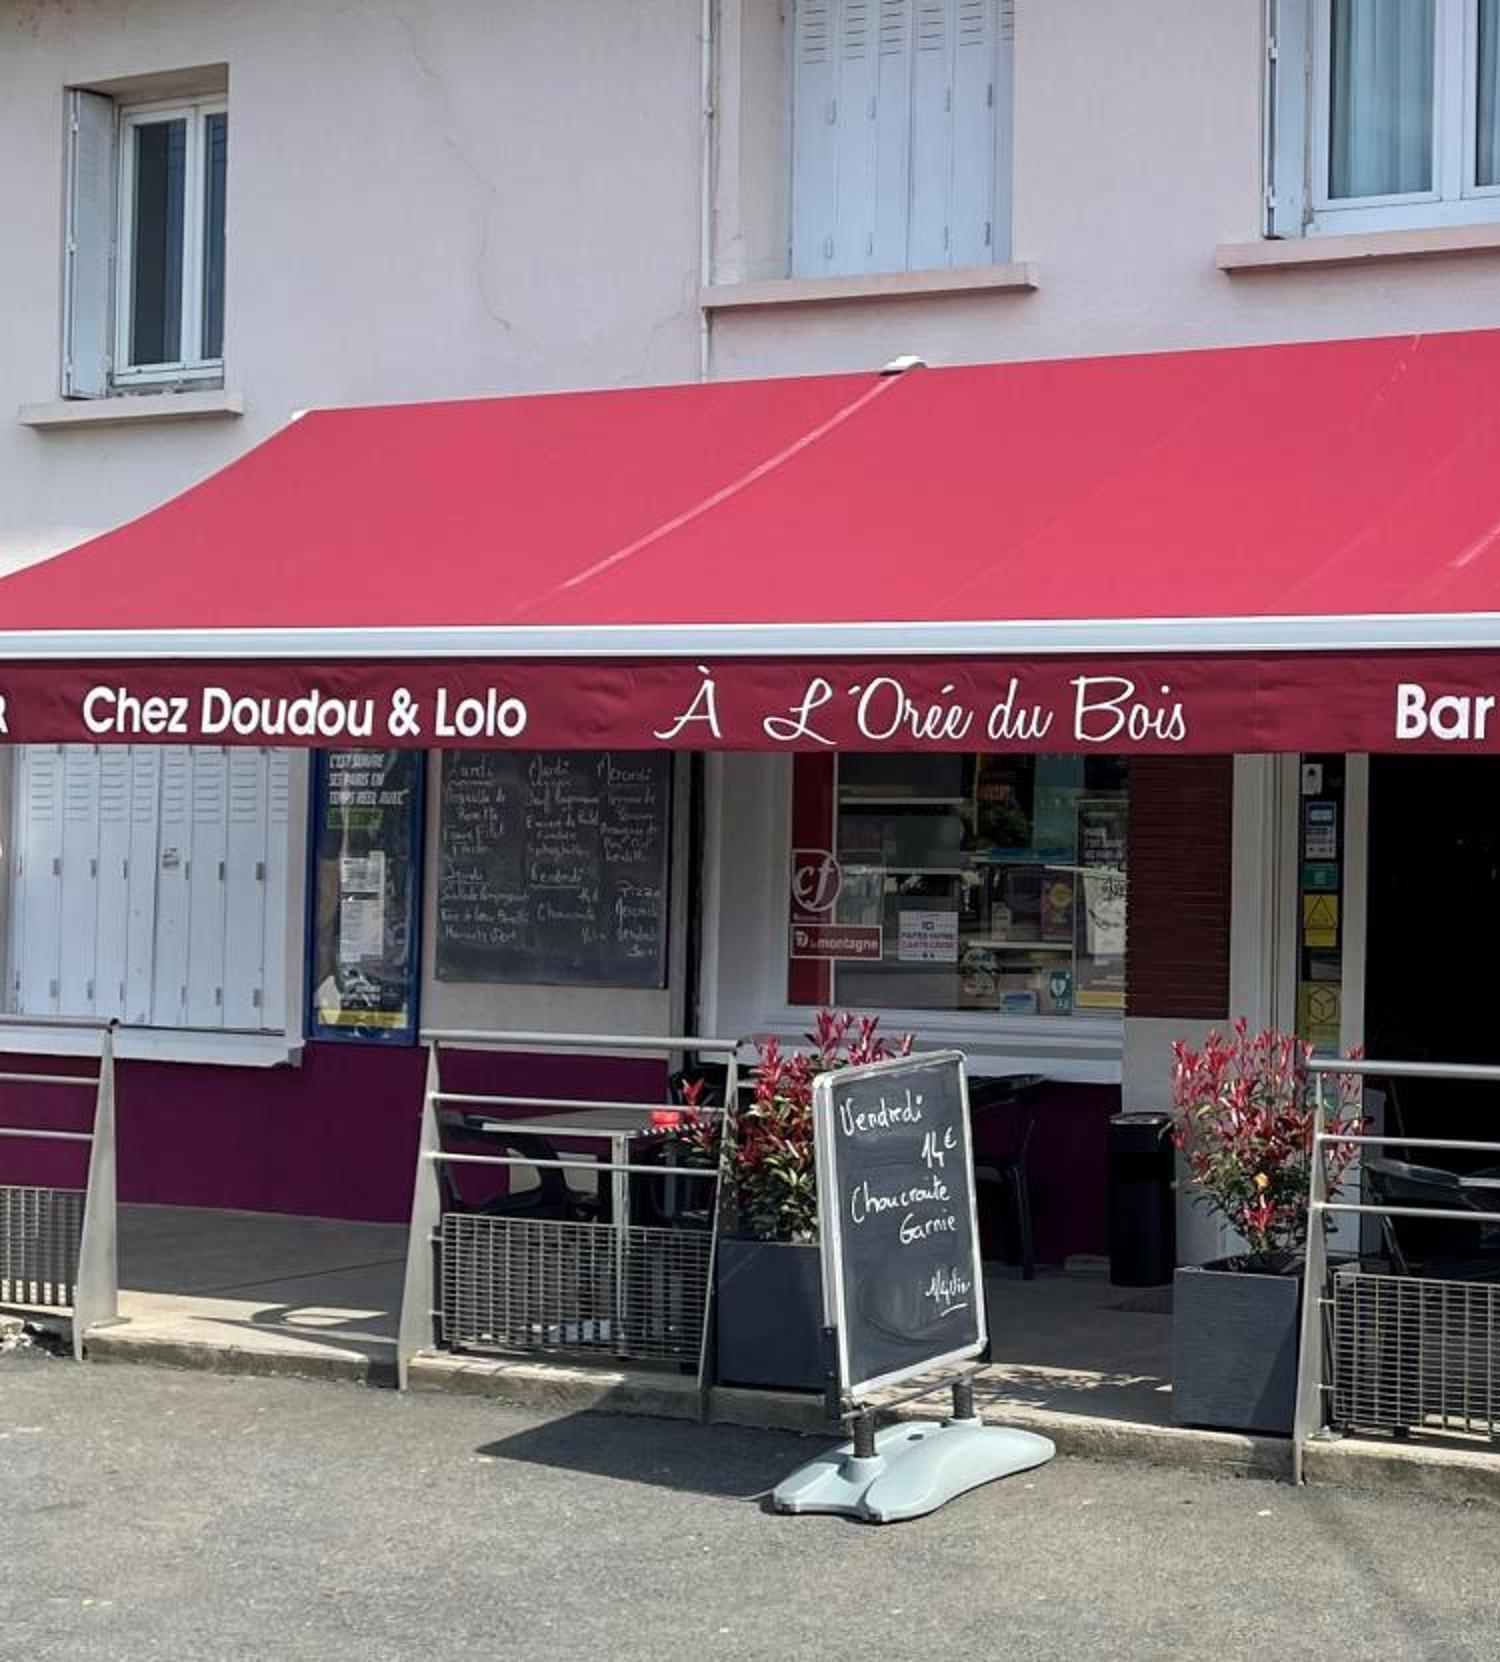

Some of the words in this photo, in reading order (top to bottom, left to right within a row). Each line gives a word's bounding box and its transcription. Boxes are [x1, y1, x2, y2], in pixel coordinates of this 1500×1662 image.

[83, 685, 189, 733] Chez
[202, 688, 374, 736] Doudou
[387, 688, 421, 736] &
[435, 688, 527, 736] Lolo
[654, 666, 720, 738] À
[988, 679, 1053, 739] du
[1070, 677, 1187, 741] Bois
[1396, 683, 1495, 740] Bar
[817, 936, 879, 952] montagne
[841, 1089, 923, 1136] Vendredi
[851, 1176, 951, 1223] Choucroute
[900, 1210, 957, 1244] Garnie
